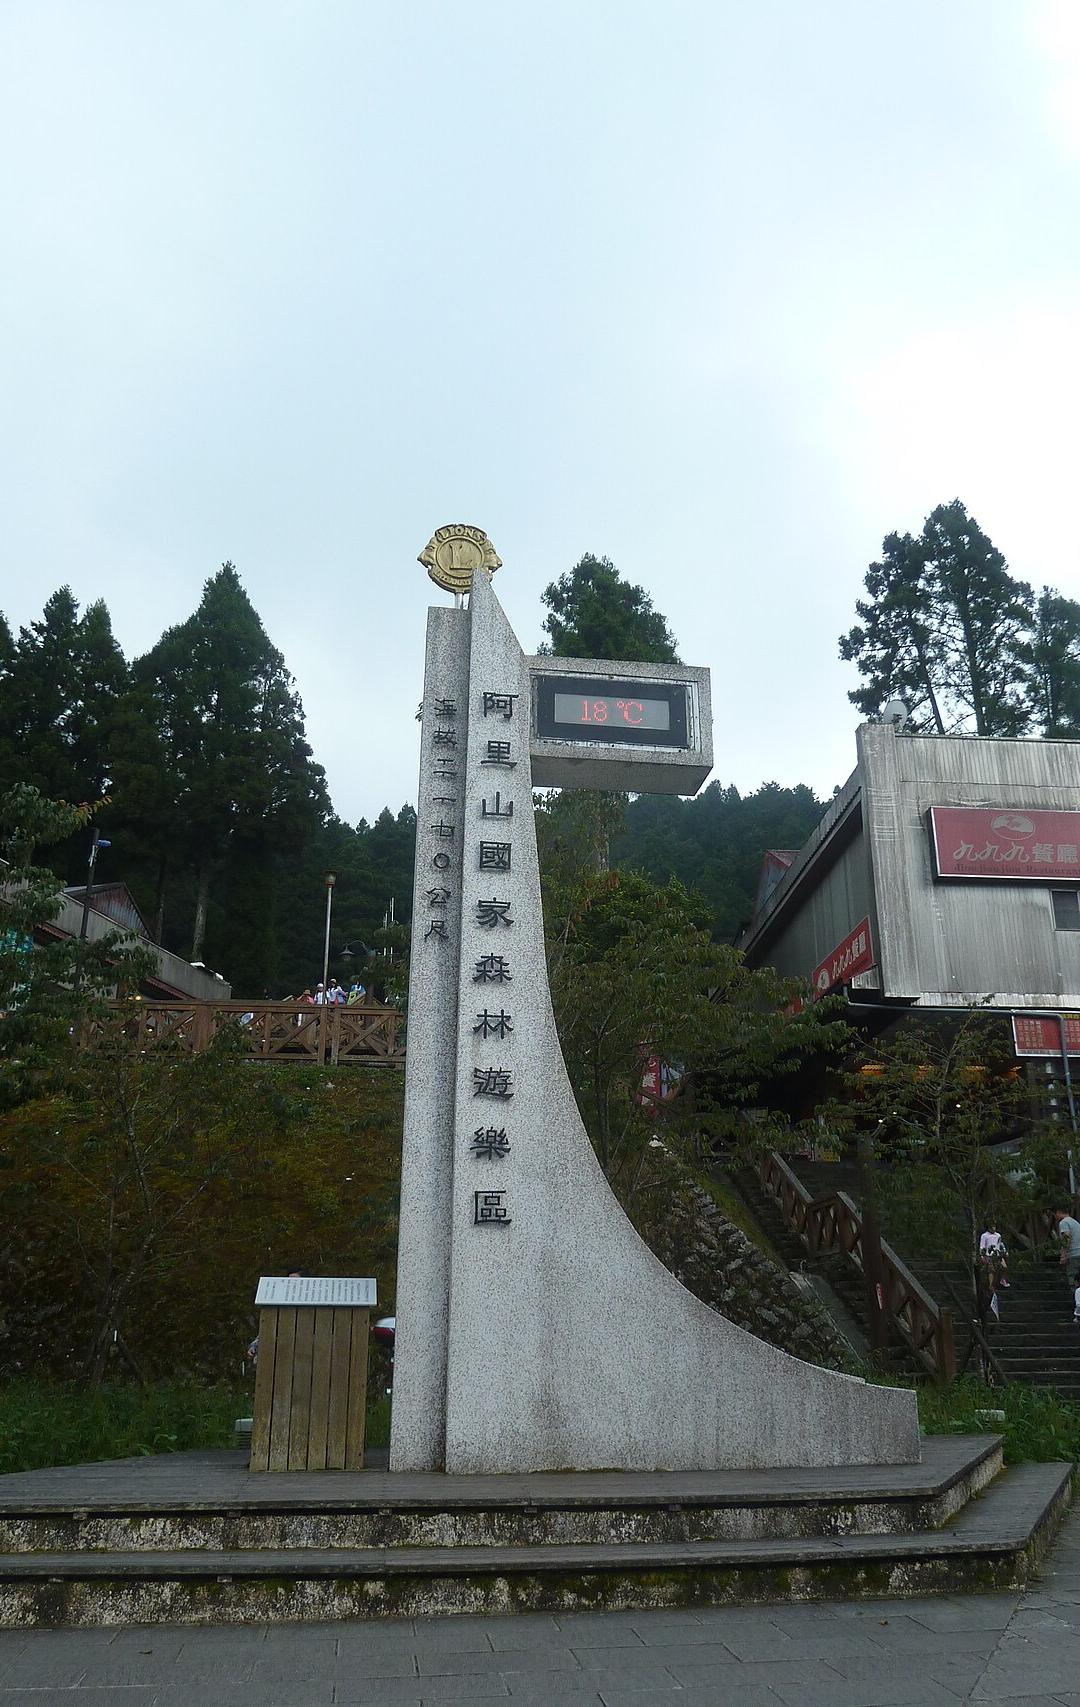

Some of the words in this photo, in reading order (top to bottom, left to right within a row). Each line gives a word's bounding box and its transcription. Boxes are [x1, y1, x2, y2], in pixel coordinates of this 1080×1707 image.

[436, 525, 487, 546] LIONS
[581, 699, 608, 722] 18
[469, 691, 519, 1227] 阿里山國家森林遊樂區
